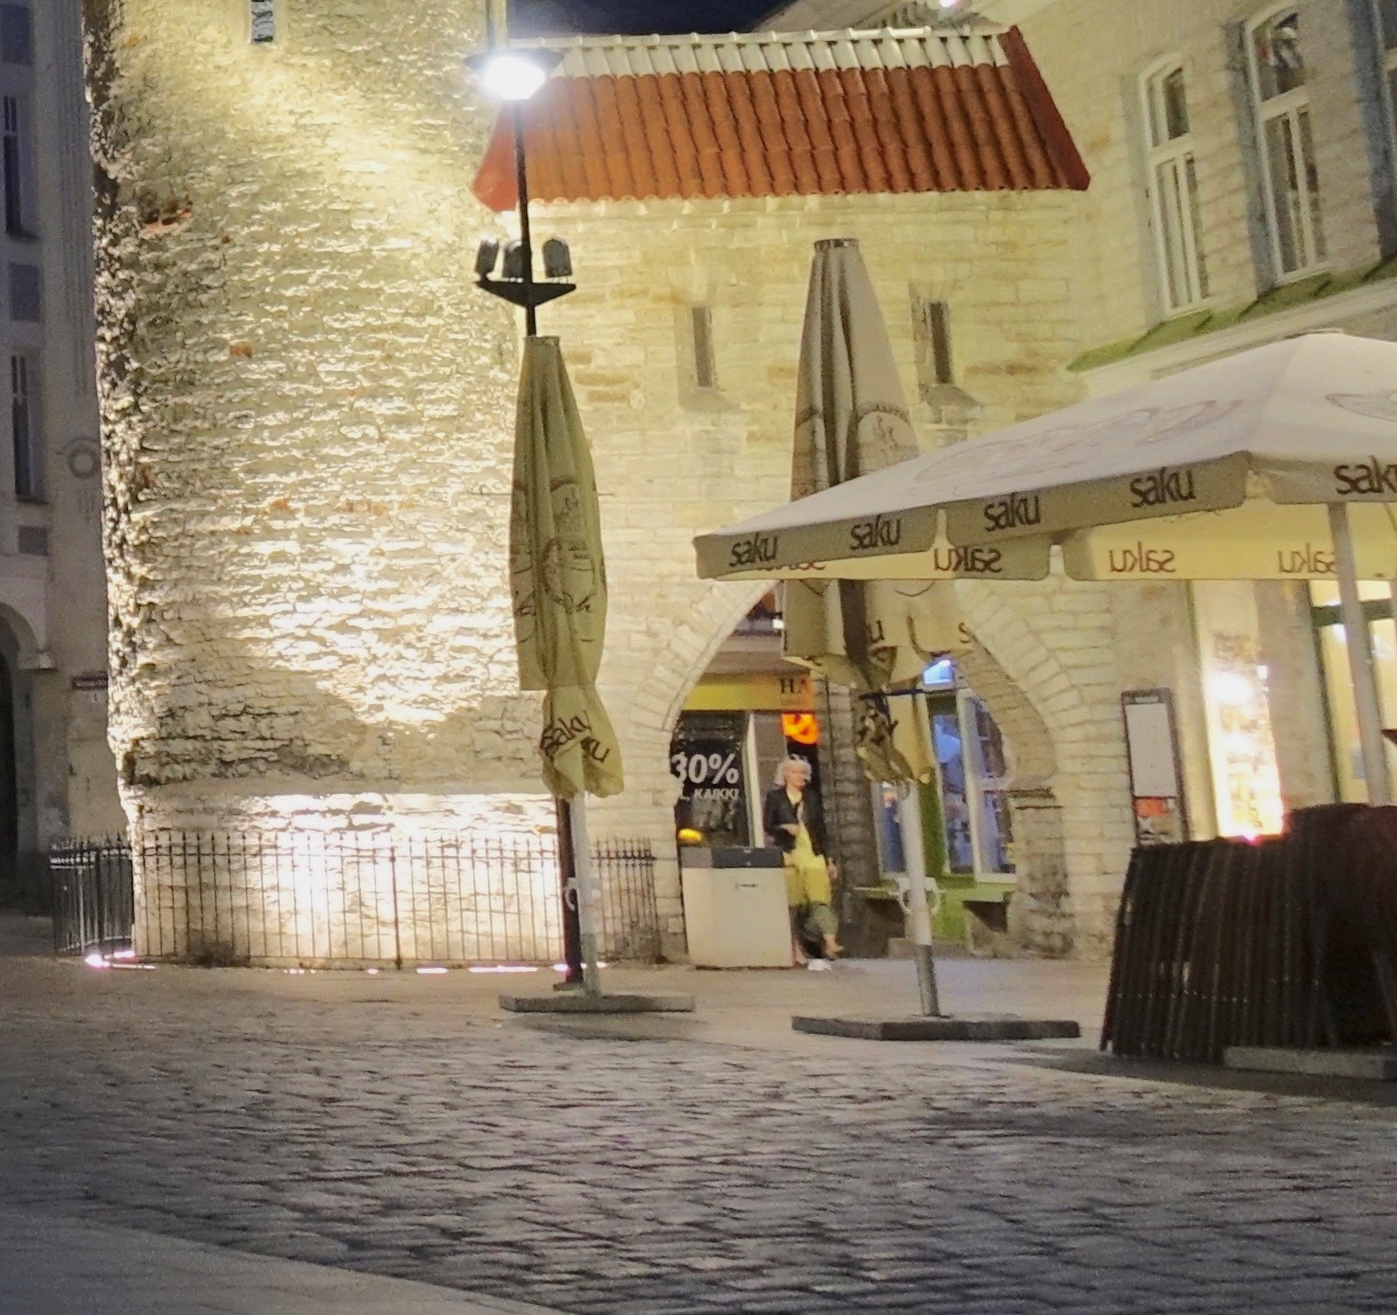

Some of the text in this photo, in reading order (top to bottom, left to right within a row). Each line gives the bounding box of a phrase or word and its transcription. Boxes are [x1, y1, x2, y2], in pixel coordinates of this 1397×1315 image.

[1129, 466, 1196, 507] saku
[1333, 454, 1397, 495] sak
[984, 492, 1041, 532] saku
[728, 533, 778, 567] saku
[850, 514, 902, 550] saku
[671, 752, 739, 785] 30%
